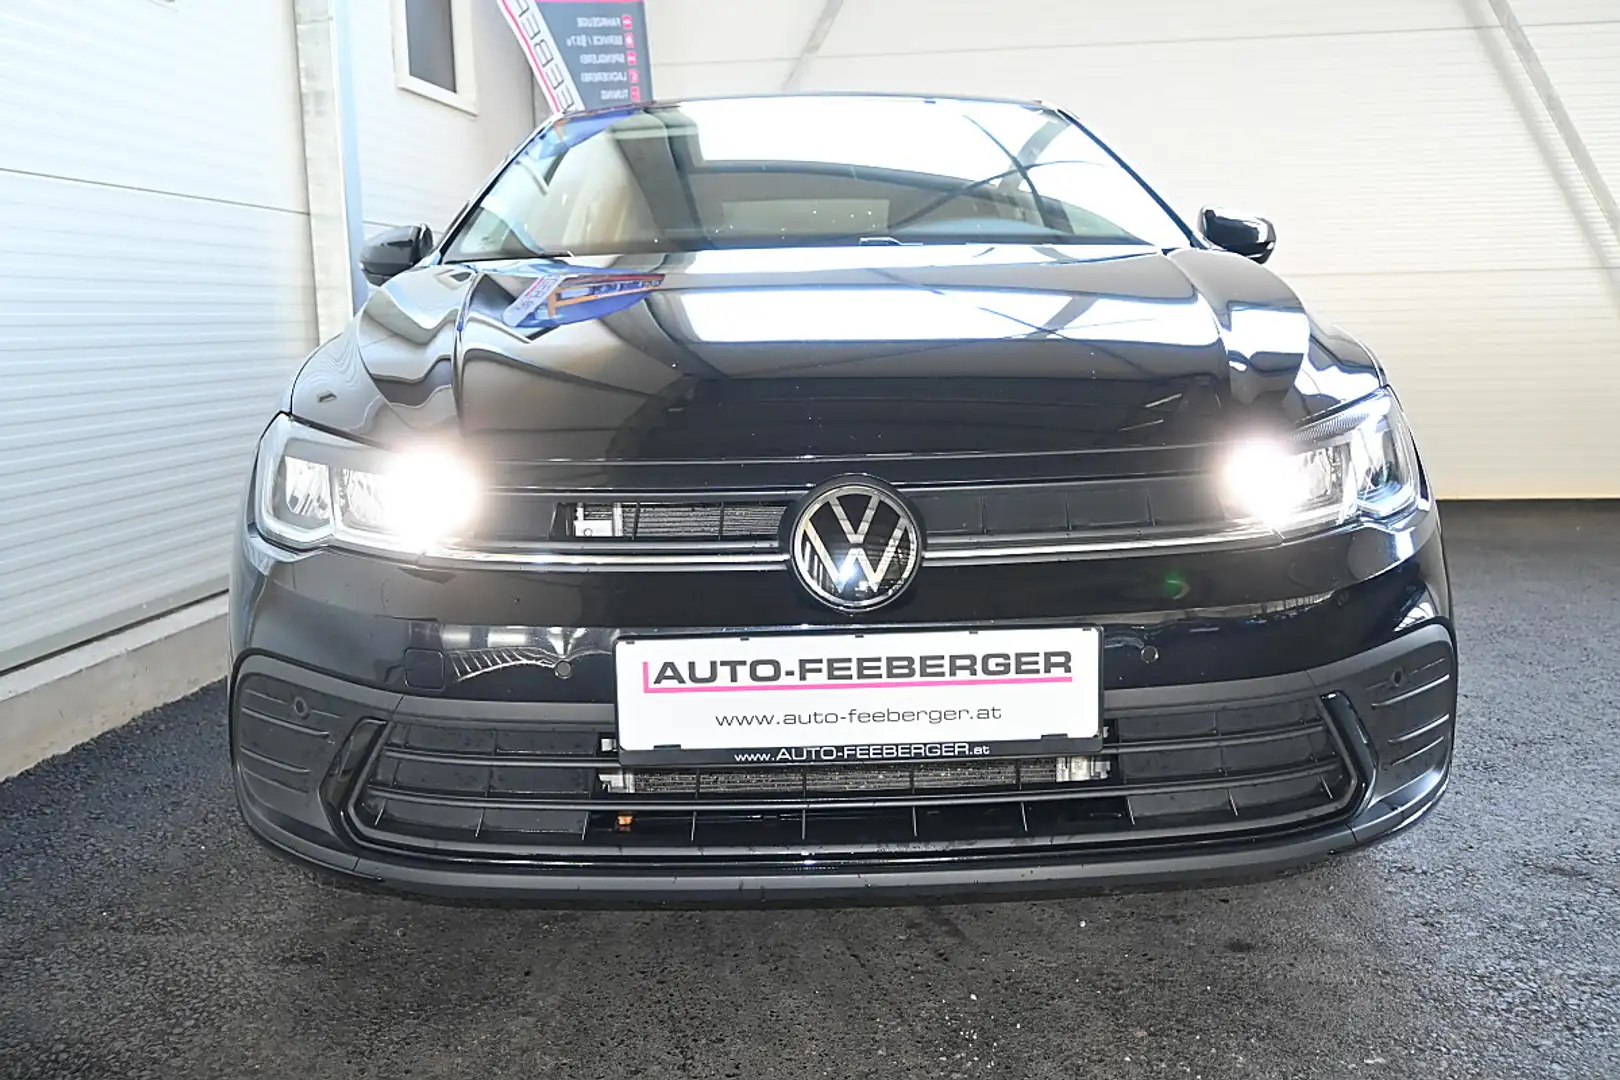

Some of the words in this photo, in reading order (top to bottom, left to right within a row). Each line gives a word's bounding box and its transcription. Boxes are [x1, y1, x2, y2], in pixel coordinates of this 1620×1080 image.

[800, 492, 911, 600] VW
[653, 651, 1073, 685] AUTO-FEEBERGER
[715, 705, 1002, 728] www.auto-feeberger.at
[734, 742, 990, 762] www.AUTO-FEEBERGER.at
